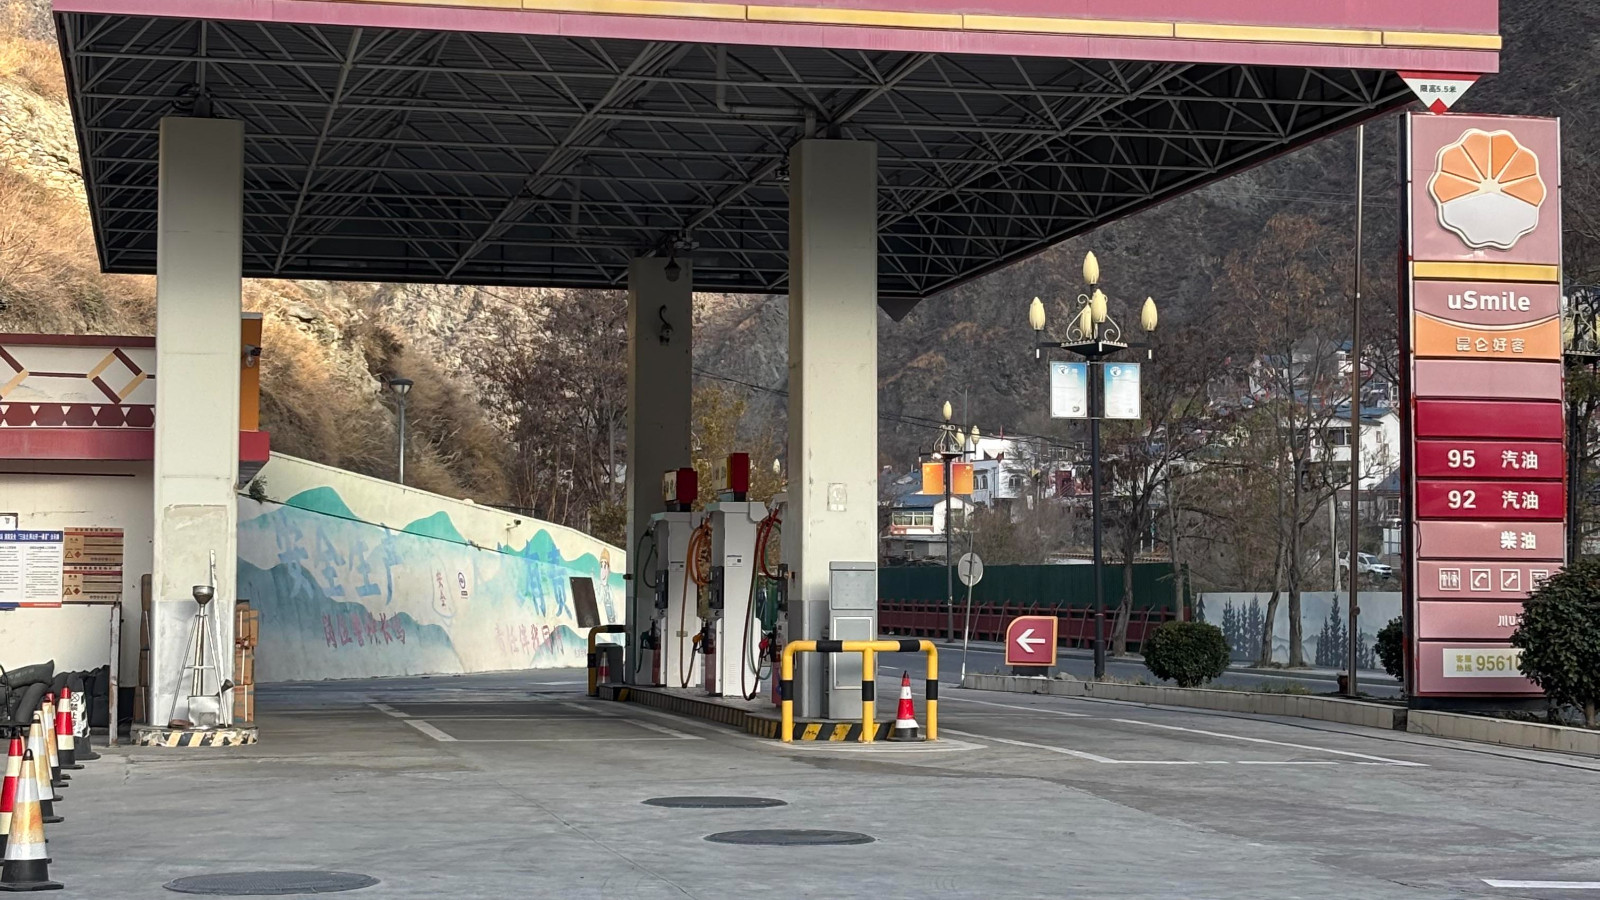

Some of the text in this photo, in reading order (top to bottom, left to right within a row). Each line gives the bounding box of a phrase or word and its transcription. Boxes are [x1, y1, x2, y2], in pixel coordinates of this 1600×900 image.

[1420, 84, 1457, 93] 限高5.5米
[1447, 290, 1531, 312] uSmile
[1456, 336, 1525, 353] 昆仑好客
[1447, 449, 1538, 470] 95 汽油
[1447, 489, 1539, 510] 92 汽油
[1500, 530, 1537, 550] 柴油
